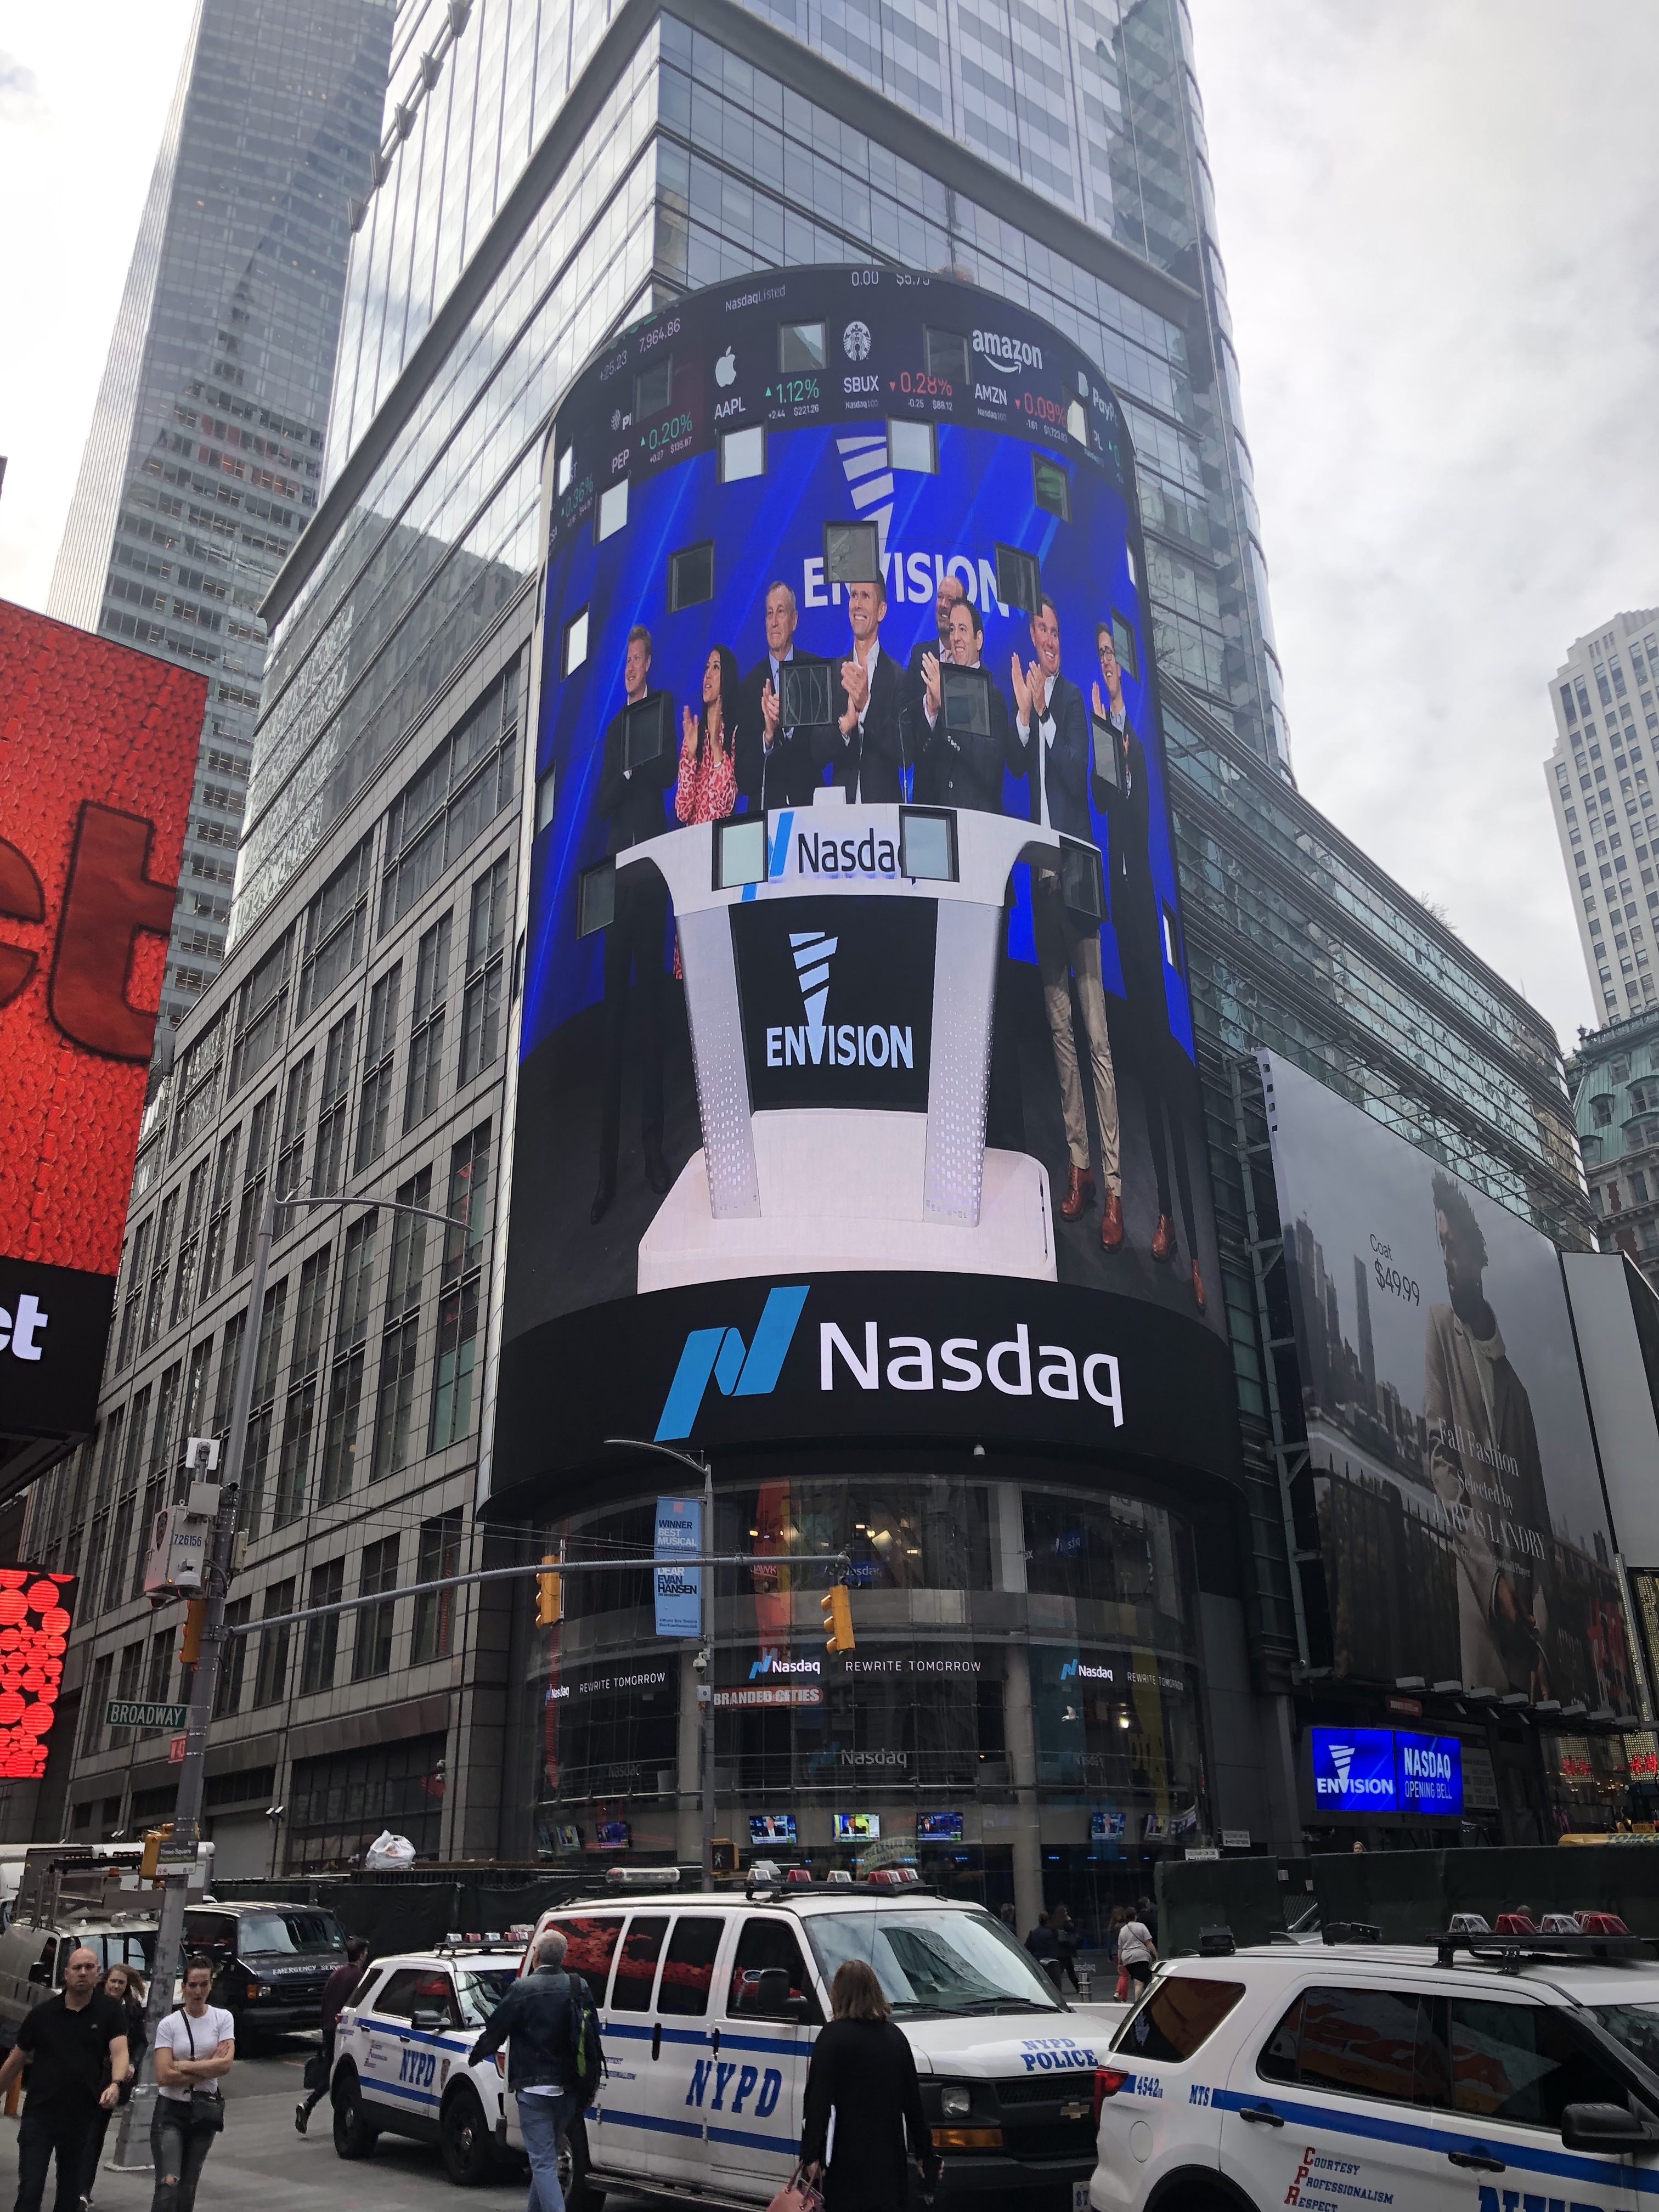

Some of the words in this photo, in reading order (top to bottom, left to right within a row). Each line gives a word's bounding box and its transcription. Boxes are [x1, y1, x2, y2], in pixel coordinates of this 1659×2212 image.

[972, 329, 1043, 370] amazon
[843, 375, 879, 394] SBUX
[714, 397, 746, 421] AAPL
[776, 377, 820, 404] 1.12%
[974, 383, 1008, 407] AMZN
[1024, 392, 1067, 428] 0.09%
[612, 448, 630, 473] PEP
[649, 411, 692, 450] 0.20%
[798, 828, 916, 885] Nasda
[766, 1024, 913, 1069] ENVISION
[1369, 1233, 1393, 1261] Coat
[1374, 1257, 1420, 1307] $49.99
[820, 1321, 1124, 1428] Nasdaq
[1437, 1417, 1466, 1454] Fall
[1467, 1430, 1520, 1477] Fashion
[1457, 1469, 1500, 1505] Selected
[1501, 1485, 1514, 1516] by
[658, 1520, 693, 1530] WINNER
[658, 1528, 681, 1537] BEST
[1487, 1513, 1546, 1560] LANDRY
[174, 1534, 202, 1547] 726156
[658, 1537, 697, 1547] MUSICAL
[657, 1566, 685, 1576] DEAR
[658, 1575, 683, 1585] EVAN
[658, 1584, 697, 1595] HANSEN
[771, 1659, 821, 1675] Nasdaq
[845, 1660, 902, 1673] REWRITE
[908, 1661, 981, 1673] TOMORROW
[1078, 1664, 1114, 1682] Nasdaq
[1127, 1672, 1156, 1685] REWRITE
[551, 1684, 570, 1700] Nasdaq
[579, 1678, 610, 1694] REWRITE
[614, 1672, 665, 1688] TOMORROW
[714, 1690, 773, 1706] BRANDED
[110, 1704, 182, 1726] BROADWAY
[840, 1748, 908, 1769] Nasdaq
[1403, 1747, 1451, 1782] NASDAQ
[1317, 1778, 1394, 1795] ENVISION
[1404, 1780, 1435, 1799] OPENING
[1436, 1782, 1453, 1799] BELL
[272, 1965, 317, 1975] EMERGENCY
[1074, 1962, 1096, 1973] asdaq
[1020, 2038, 1076, 2051] NYPD
[399, 2047, 436, 2087] NYPD
[1019, 2049, 1099, 2072] POLICE
[685, 2058, 783, 2118] NYPD
[1137, 2076, 1160, 2097] 4542
[1189, 2084, 1211, 2107] MTS
[1303, 2146, 1361, 2176] COURTESY
[1294, 2165, 1394, 2205] PROFESSIONALISM
[1284, 2185, 1339, 2212] RESPECT
